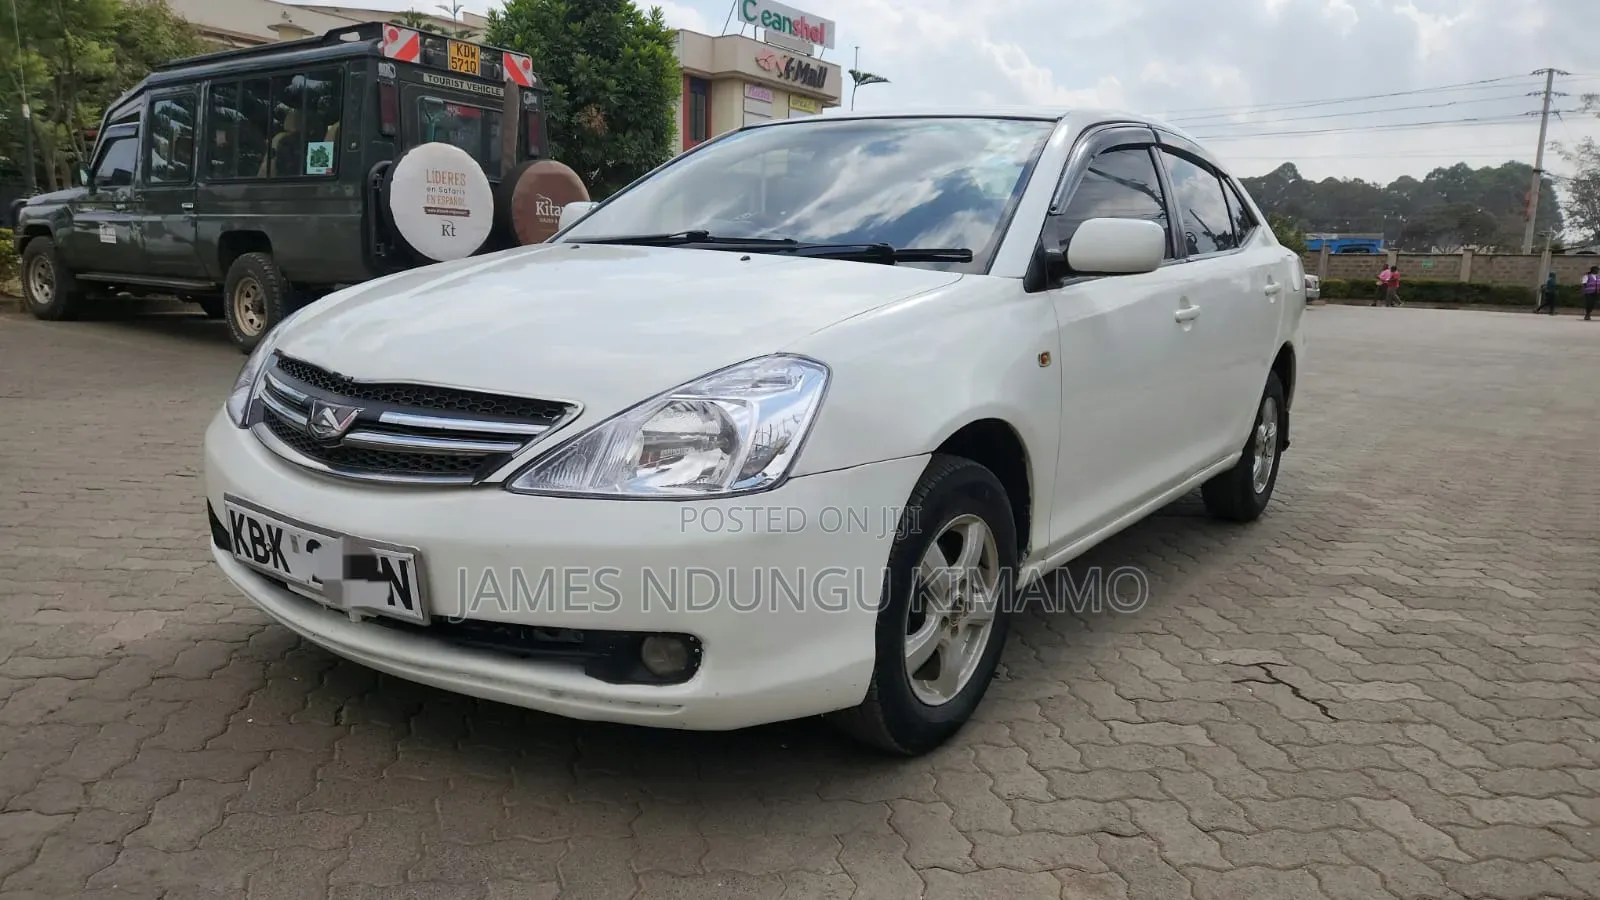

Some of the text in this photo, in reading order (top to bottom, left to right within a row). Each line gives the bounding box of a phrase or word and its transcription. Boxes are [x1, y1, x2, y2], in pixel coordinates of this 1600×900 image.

[456, 43, 476, 59] KDW
[428, 75, 501, 95] TOURIST VEHICLE
[441, 219, 457, 237] Kt
[229, 510, 291, 574] KBX
